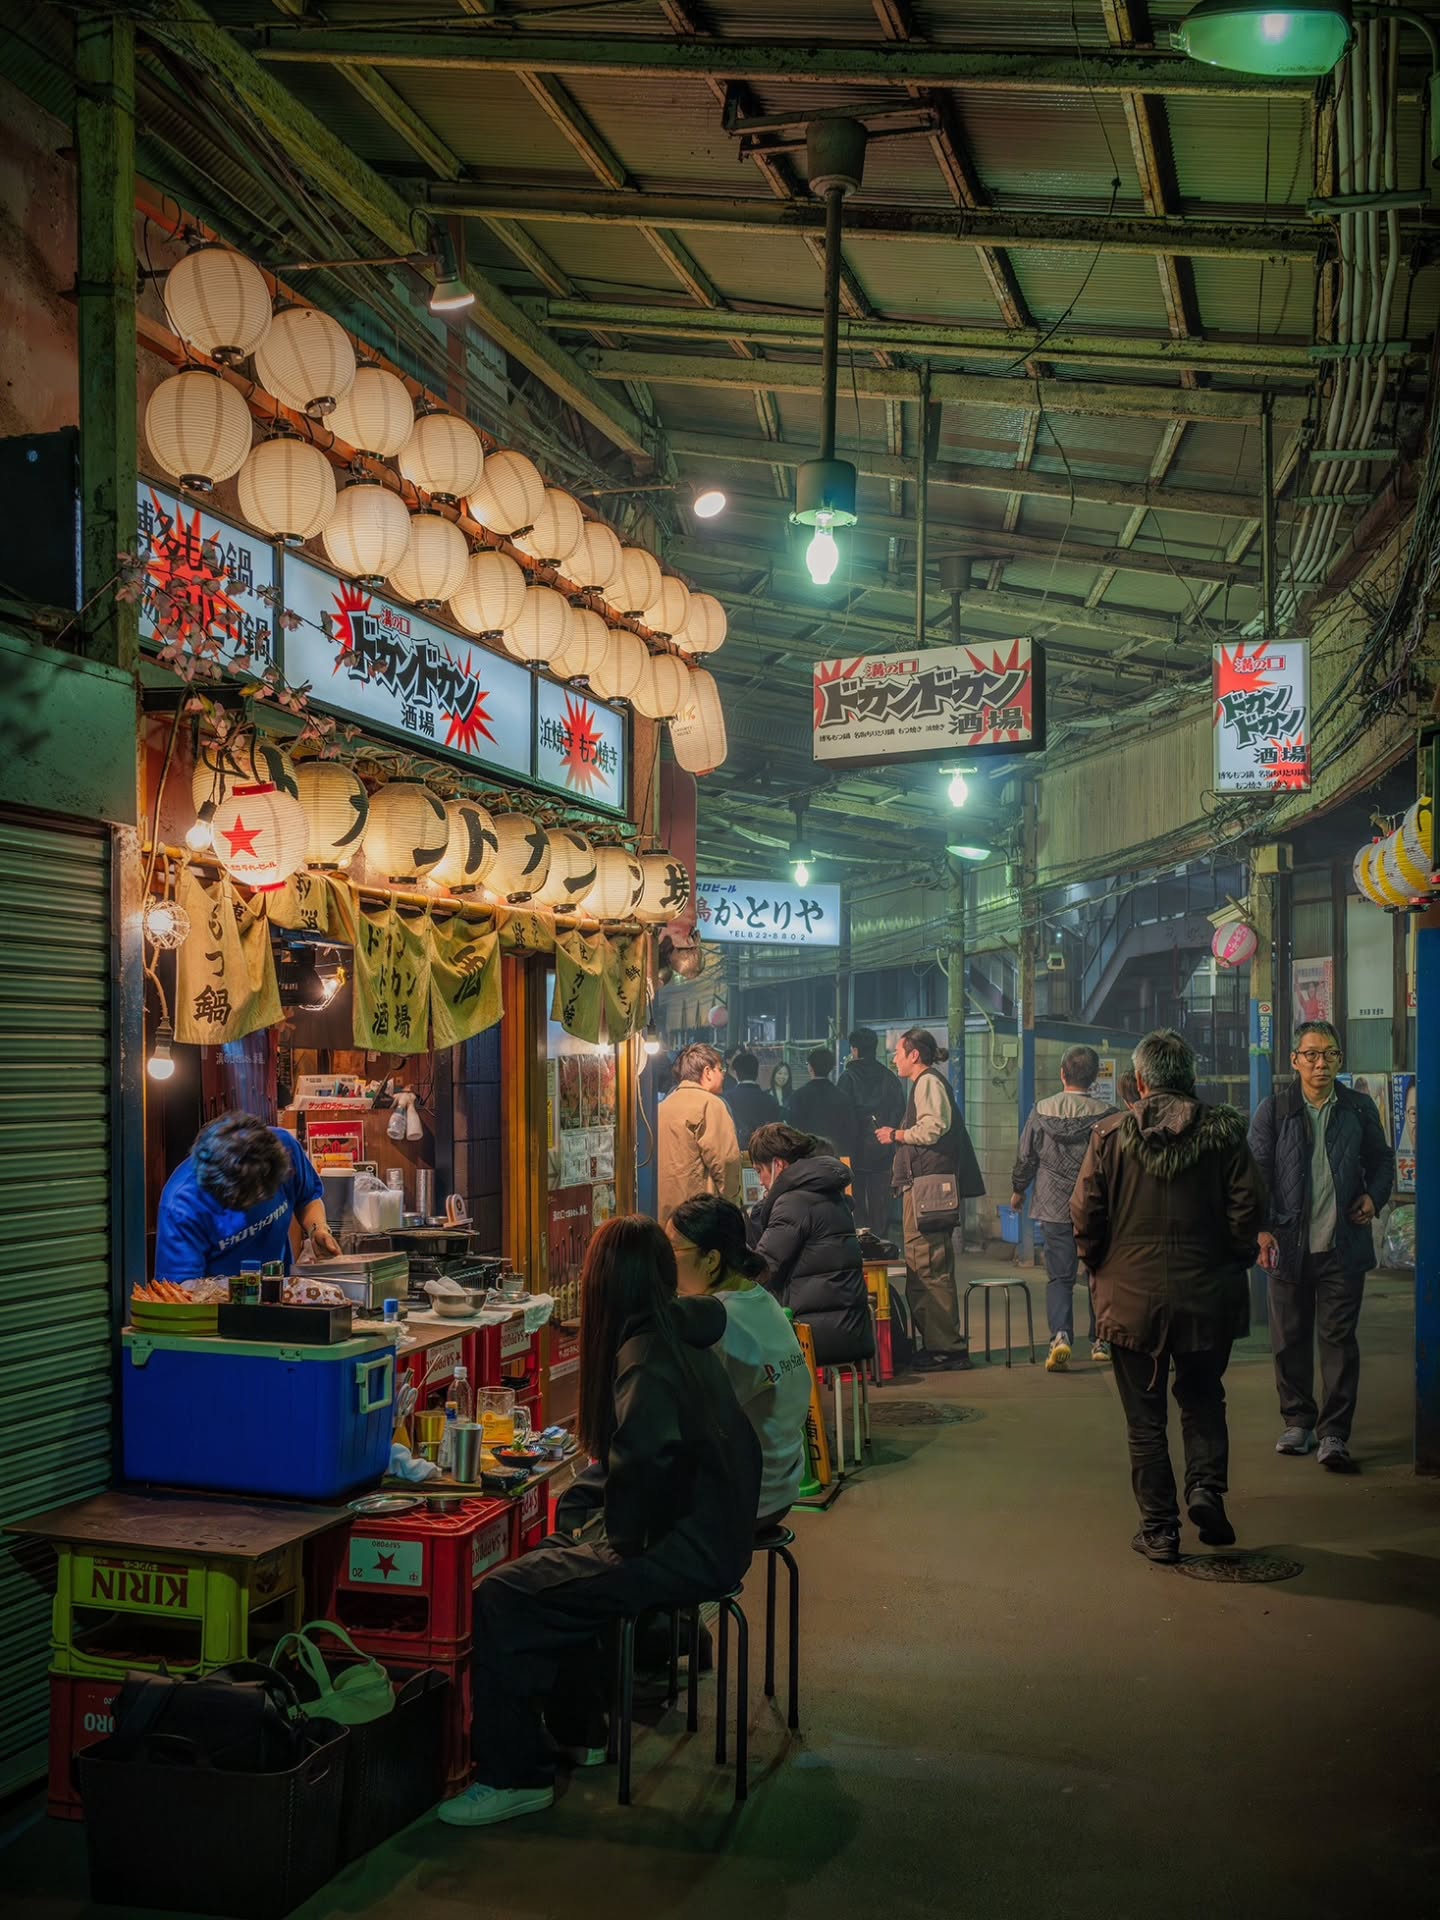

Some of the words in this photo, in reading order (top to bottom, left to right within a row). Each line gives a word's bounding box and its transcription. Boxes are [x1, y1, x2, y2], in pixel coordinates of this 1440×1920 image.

[381, 605, 411, 637] 溝の口
[347, 610, 480, 724] ドカンドカン
[866, 658, 918, 679] 溝の口
[1234, 655, 1287, 674] 溝の口
[818, 666, 1028, 728] ドカンドカン
[1218, 684, 1293, 728] ドカン
[401, 703, 435, 739] 酒場
[948, 707, 1024, 735] 酒場
[1232, 706, 1307, 750] ドカン
[579, 733, 618, 776] もつ焼き
[1254, 746, 1307, 765] 酒場
[92, 1570, 188, 1608] KIRIN
